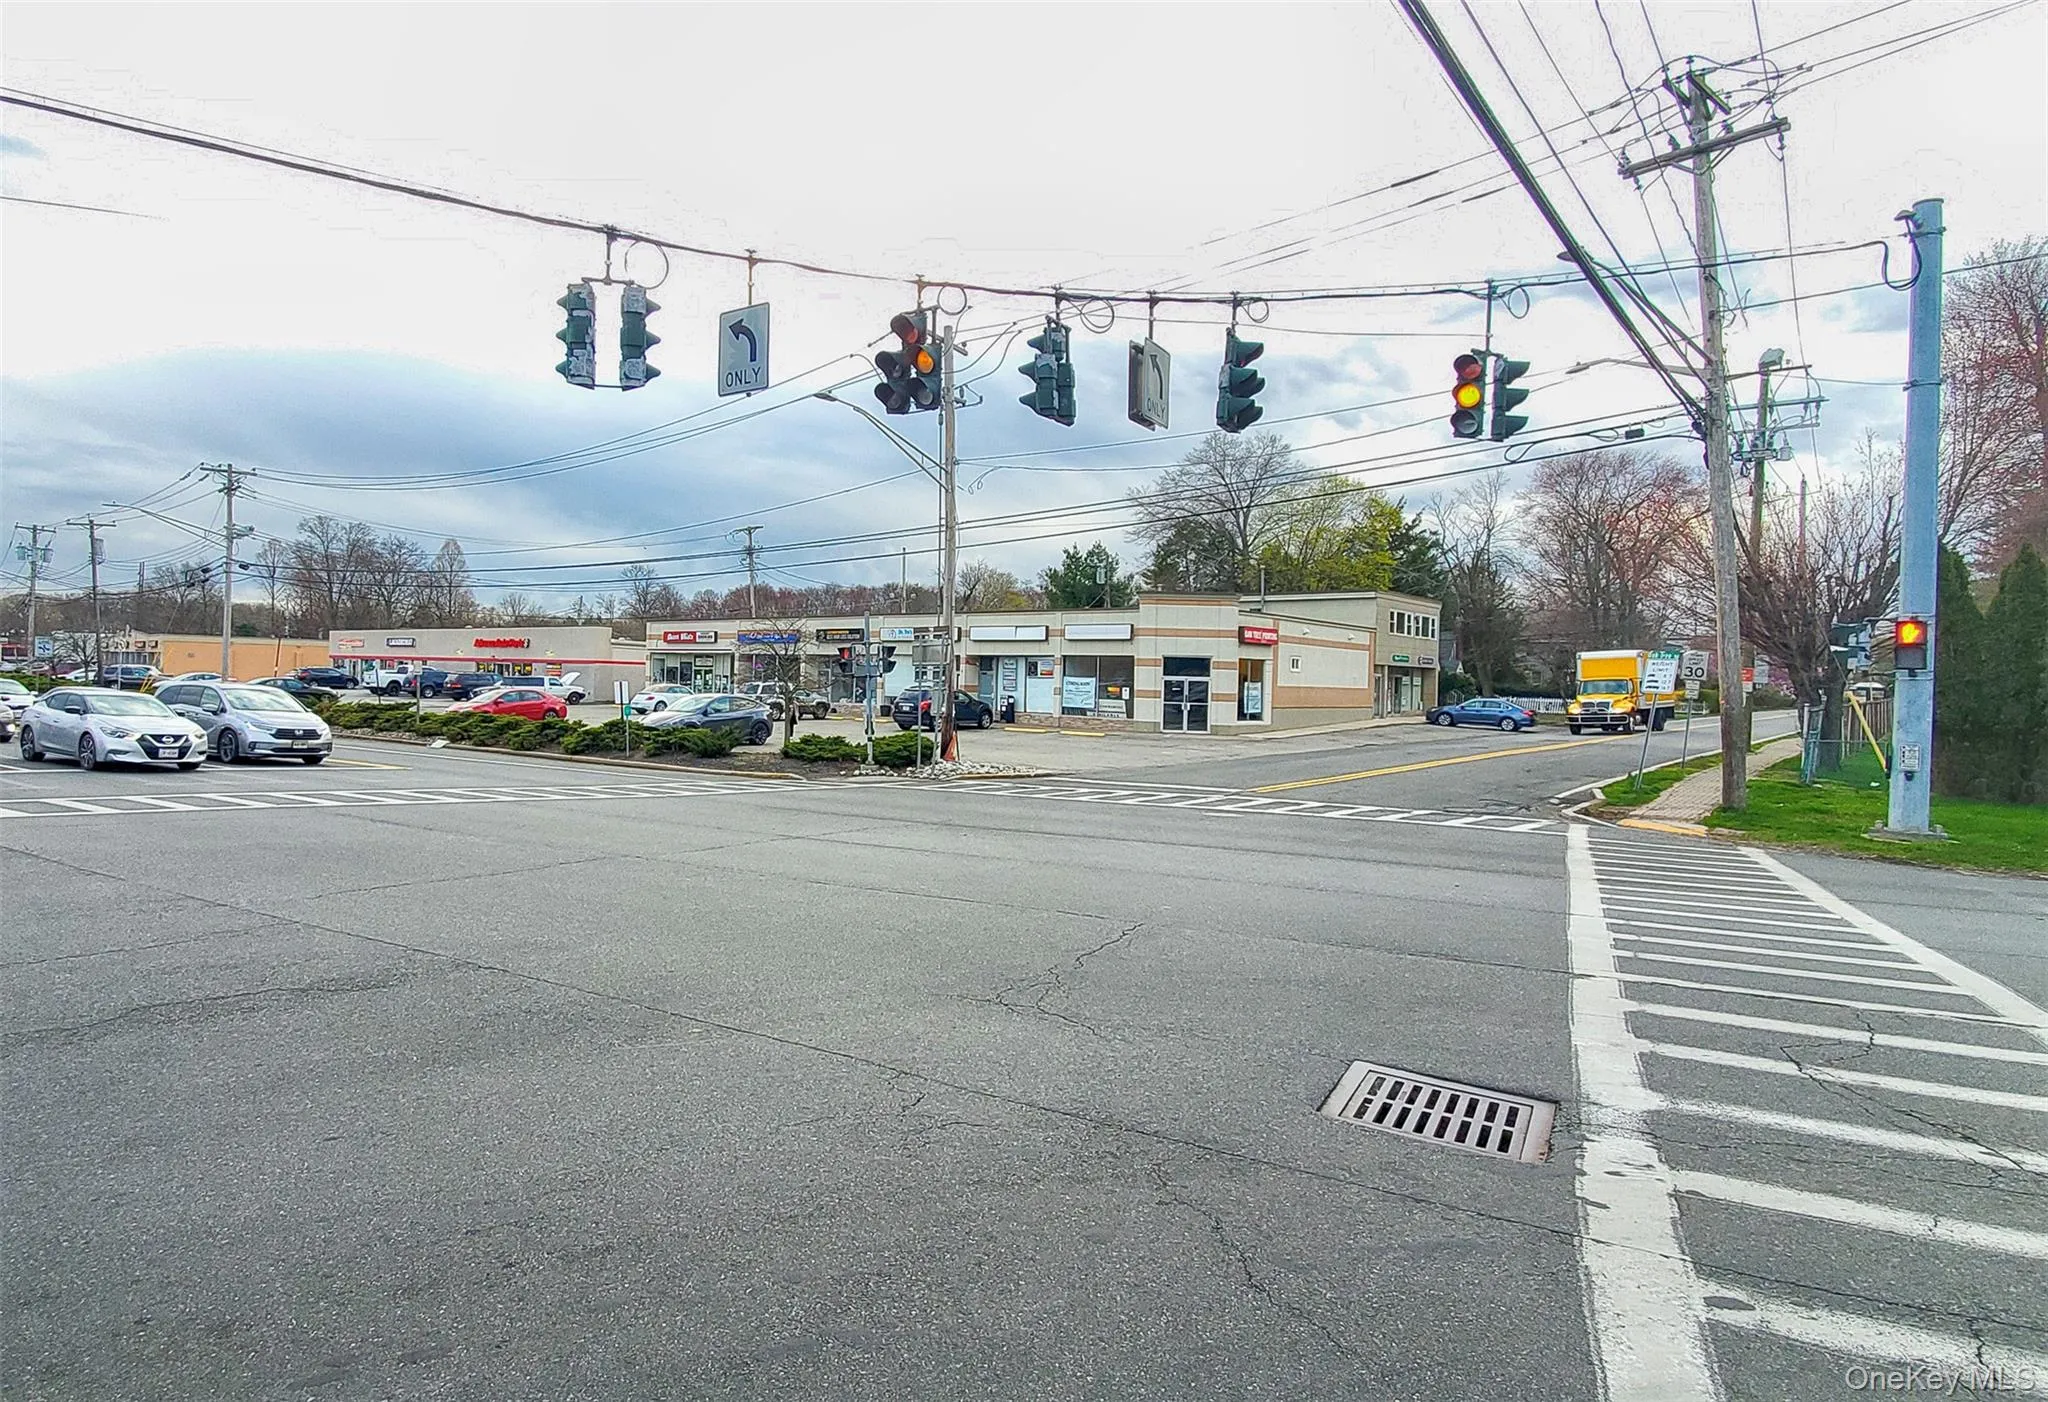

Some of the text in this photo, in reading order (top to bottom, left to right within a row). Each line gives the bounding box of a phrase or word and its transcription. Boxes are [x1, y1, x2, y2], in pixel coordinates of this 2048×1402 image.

[725, 366, 761, 388] ONLY
[1146, 397, 1166, 419] ONLY
[1683, 666, 1705, 678] 30
